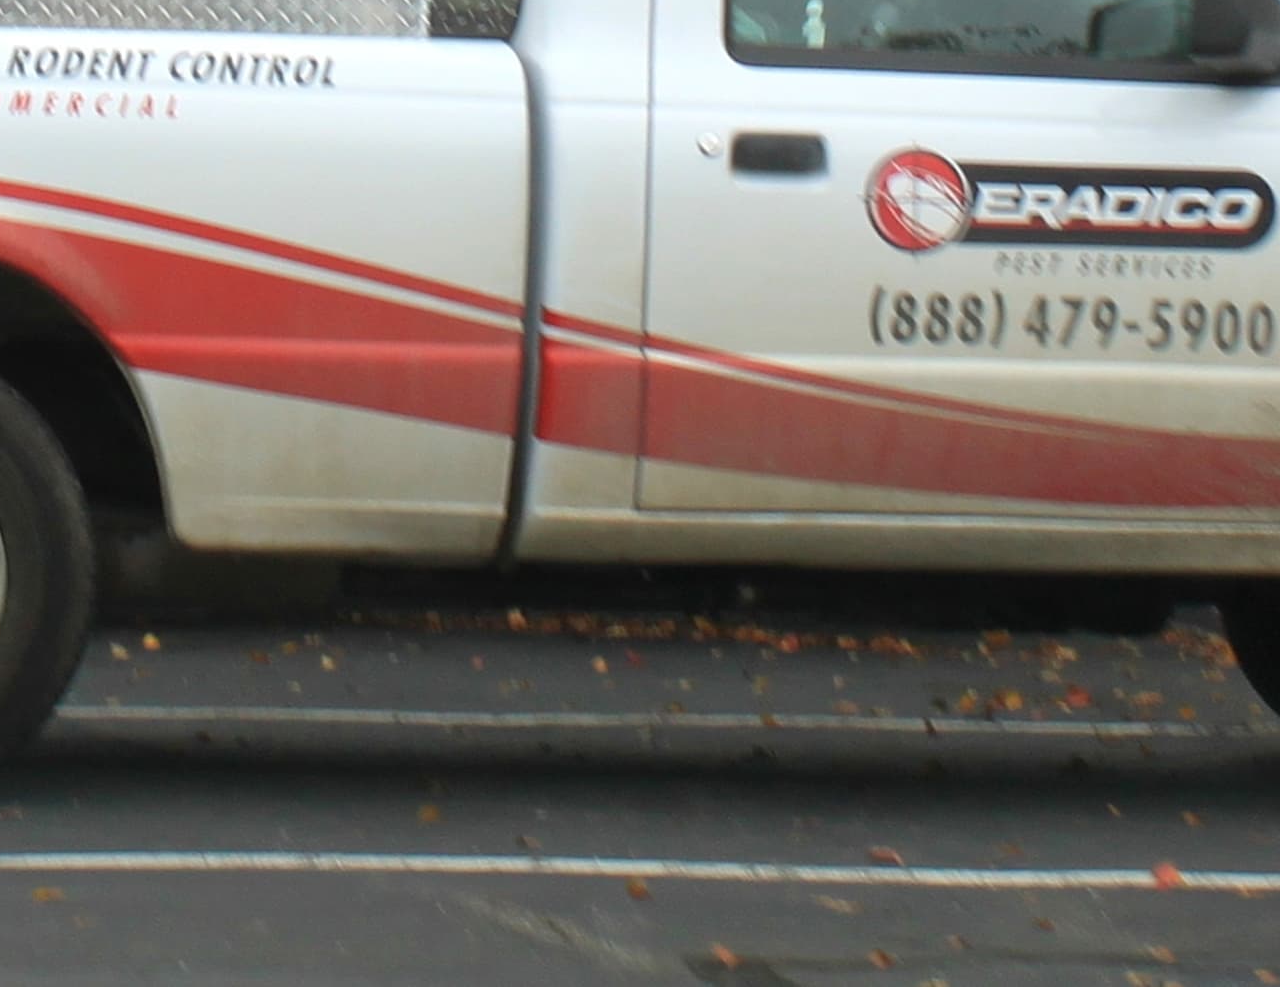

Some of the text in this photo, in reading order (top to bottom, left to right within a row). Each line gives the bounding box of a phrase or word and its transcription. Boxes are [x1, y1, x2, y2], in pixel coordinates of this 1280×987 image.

[8, 46, 155, 81] RODENT
[168, 51, 336, 88] CONTROL
[973, 181, 1263, 231] ERADICO
[993, 252, 1216, 279] PEST SERVICES
[868, 284, 1277, 356] (888) 479-5900
